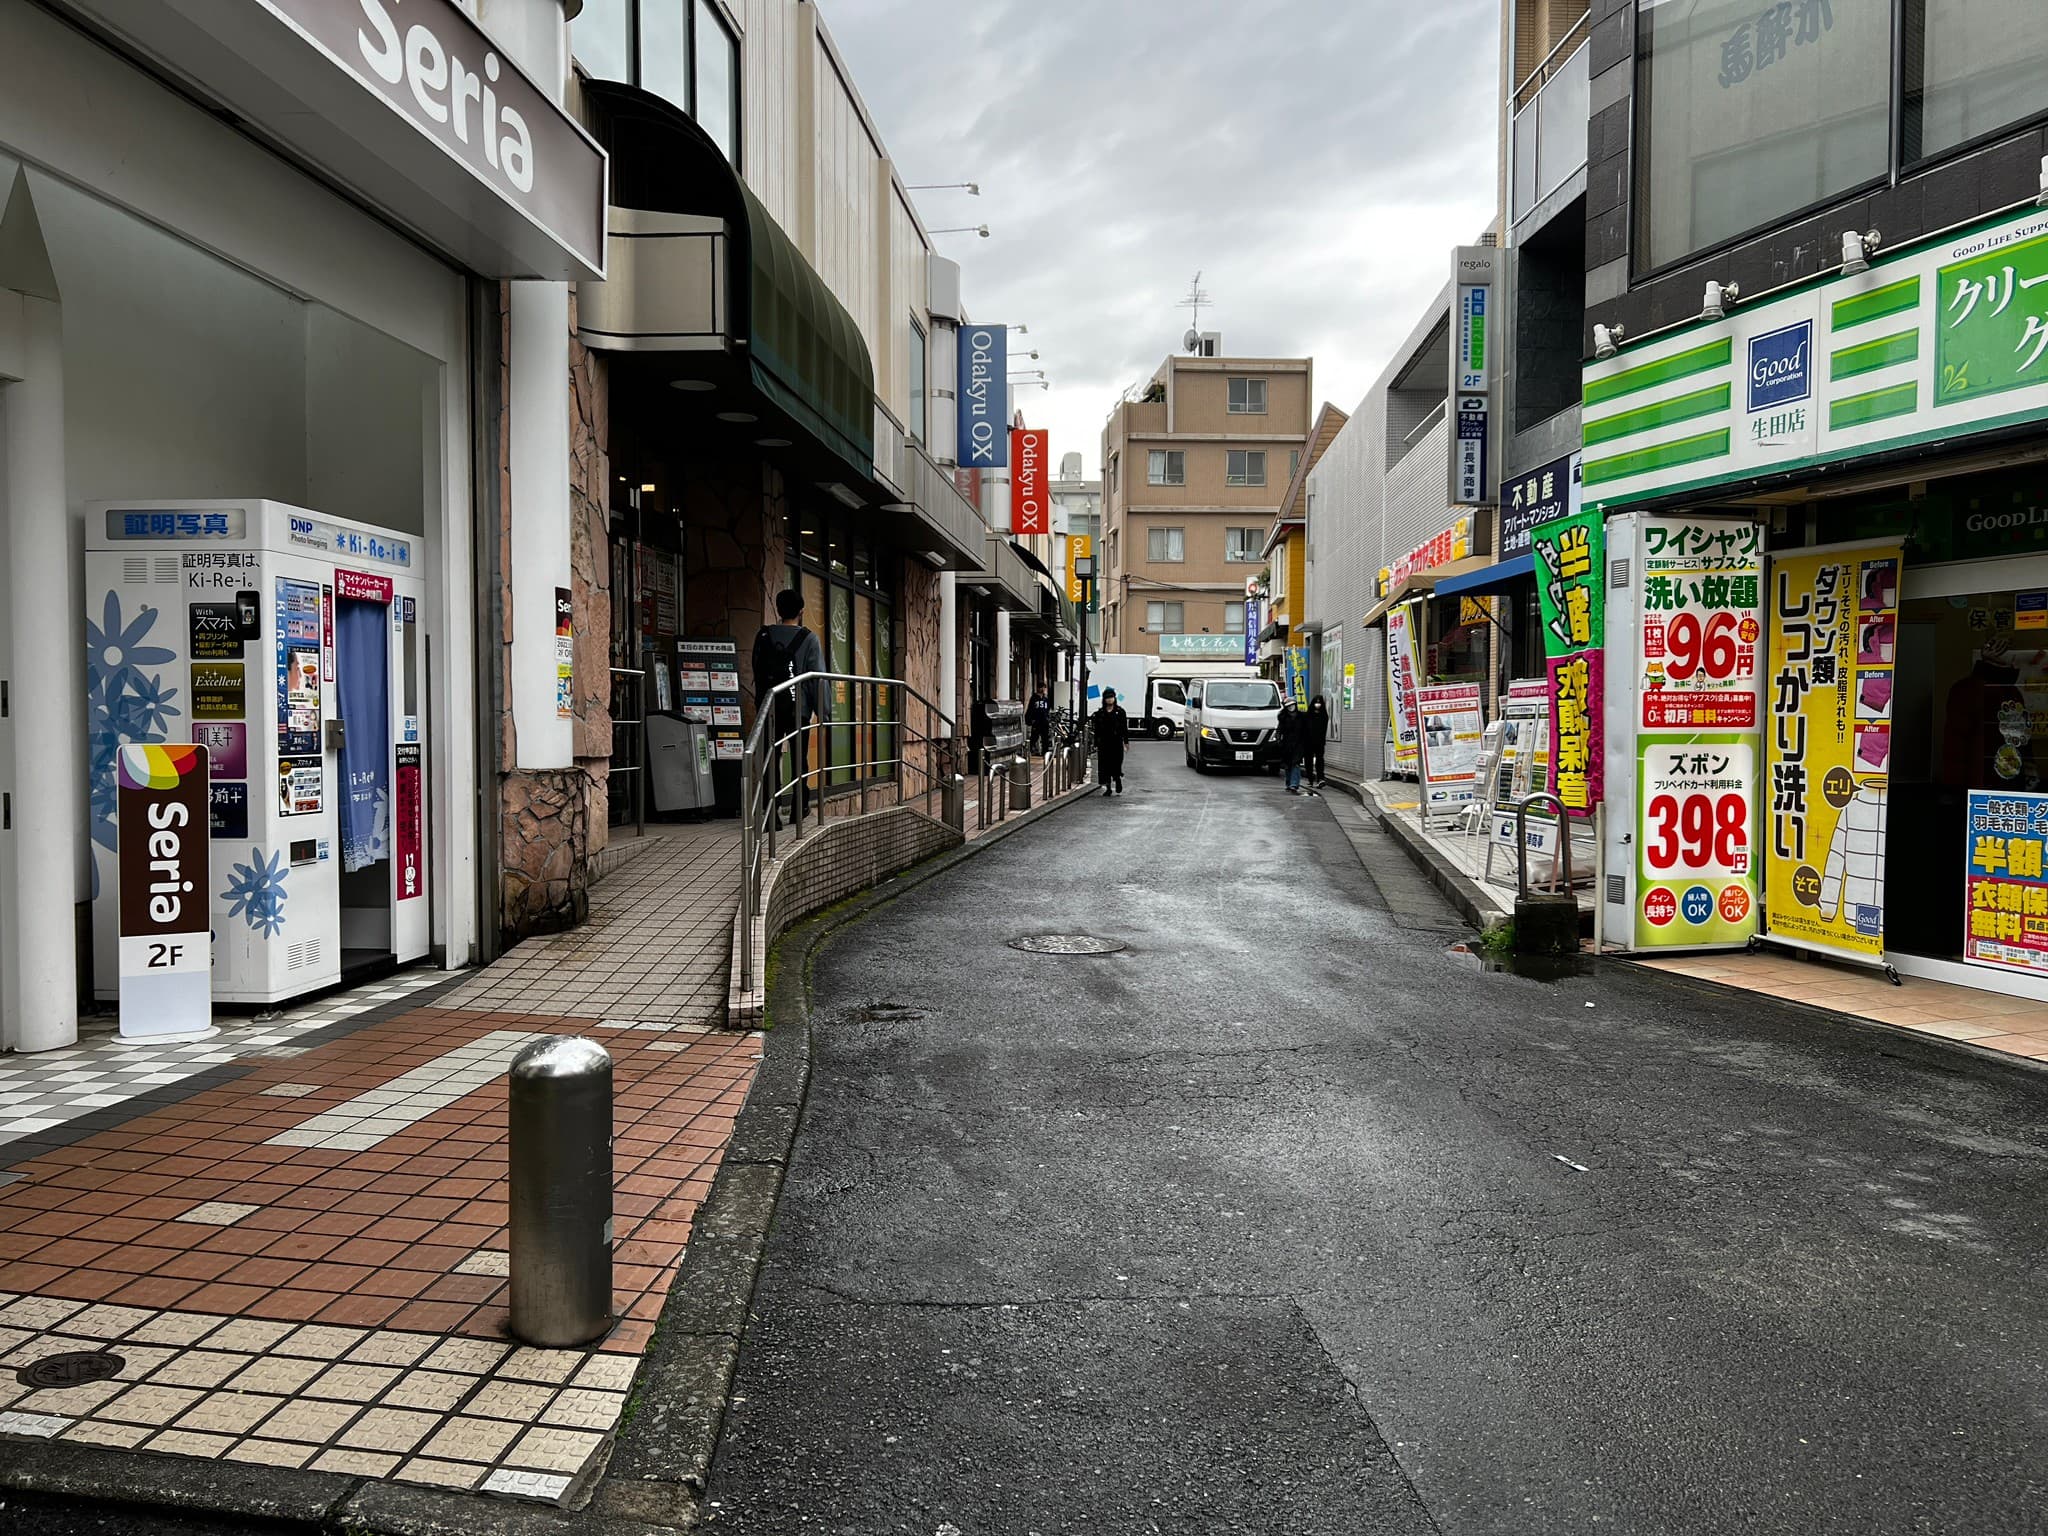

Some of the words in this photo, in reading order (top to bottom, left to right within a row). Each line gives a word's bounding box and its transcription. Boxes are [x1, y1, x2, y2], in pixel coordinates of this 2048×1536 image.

[358, 0, 534, 193] Seria
[1460, 259, 1491, 271] regalo
[966, 331, 992, 417] Odakyu
[1754, 340, 1806, 388] Good
[1464, 374, 1481, 387] 2F
[1766, 371, 1803, 387] corporation
[1751, 408, 1806, 441] 生田店
[971, 423, 993, 461] OX
[1018, 433, 1038, 496] Odakyu
[1512, 472, 1554, 511] 不動産
[124, 514, 228, 535] 証明写真
[1022, 500, 1038, 530] OX
[1966, 512, 2027, 532] GOOD
[291, 519, 313, 534] DNP
[291, 533, 307, 544] Photo
[349, 533, 396, 561] Ki-Re-i
[1645, 525, 1757, 556] ワイシャツ
[182, 553, 261, 568] 証明写真は、
[1701, 556, 1755, 570] サブスクで
[1869, 561, 1889, 569] Before
[1644, 575, 1758, 610] 洗い放題
[195, 608, 214, 616] With
[405, 600, 414, 614] ID
[195, 616, 236, 631] スマホ
[1811, 566, 1839, 684] ダウン類
[1869, 615, 1885, 624] After
[1666, 612, 1738, 680] 96
[1736, 655, 1755, 676] 円
[1864, 670, 1885, 679] Before
[195, 676, 242, 687] Excellent
[1664, 709, 1688, 723] 初月
[1864, 725, 1880, 733] After
[1669, 753, 1730, 775] ズボン
[1654, 779, 1743, 790] プリペイドカード利用料金
[1826, 778, 1851, 796] エリ
[1647, 793, 1748, 869] 398
[1735, 853, 1748, 869] 円
[147, 801, 194, 924] Seria
[1973, 836, 2044, 878] 半額
[1972, 881, 2048, 916] 衣類保
[1647, 905, 1674, 917] 長持ち
[1688, 904, 1707, 916] OK
[1725, 905, 1744, 917] OK
[1858, 913, 1879, 926] Good
[1971, 909, 2022, 943] 無料
[147, 943, 184, 968] 2F
